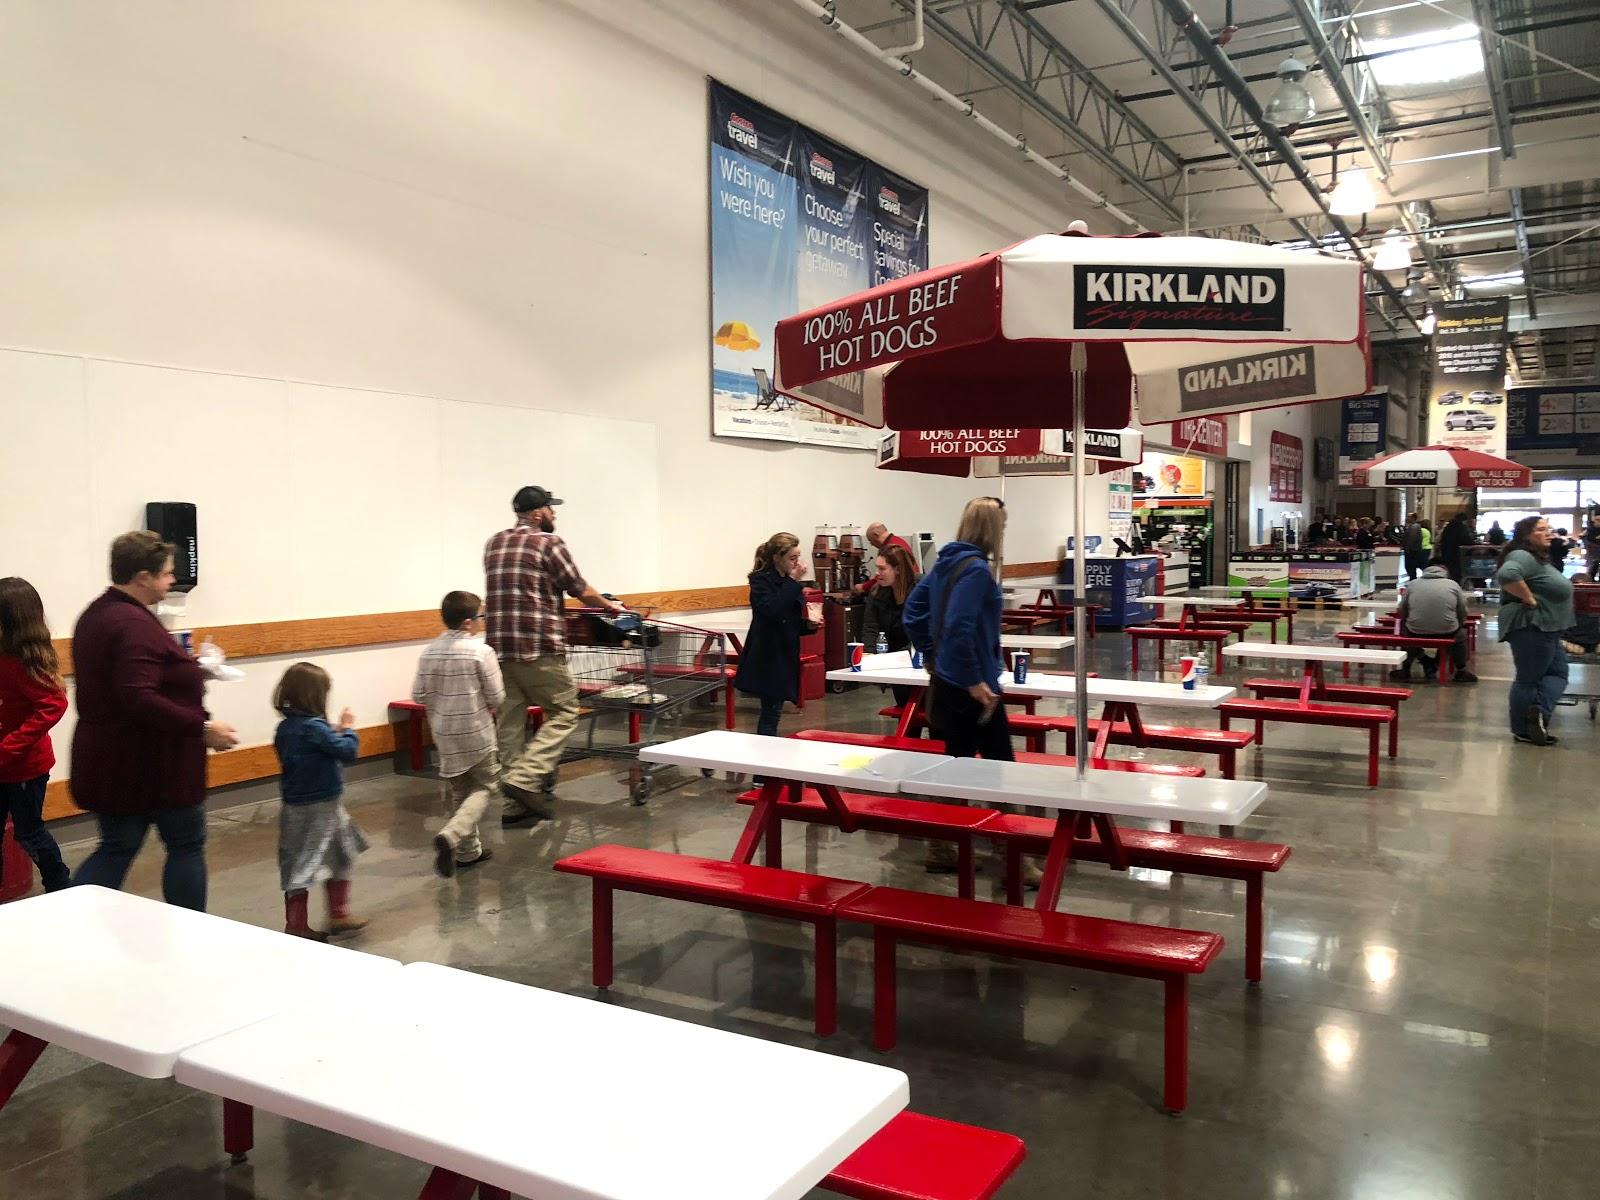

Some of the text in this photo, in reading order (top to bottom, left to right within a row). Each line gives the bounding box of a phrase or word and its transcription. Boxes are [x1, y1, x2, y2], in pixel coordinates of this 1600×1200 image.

[727, 120, 758, 149] travel
[720, 156, 775, 199] Wish you
[810, 160, 836, 185] travel
[721, 190, 785, 229] were here?
[805, 194, 844, 227] Choose
[879, 194, 900, 216] travel
[805, 224, 864, 260] your perfect
[874, 222, 905, 251] Special
[874, 250, 920, 277] savings for
[1086, 272, 1277, 304] KIRKLAND
[803, 308, 852, 345] 100%
[858, 294, 900, 330] ALL
[908, 275, 963, 317] BEEF
[1086, 302, 1276, 331] Signature
[819, 316, 938, 371] HOT DOGS
[919, 428, 1021, 440] 100% ALL BEEF
[930, 440, 1007, 454] HOT DOGS
[1065, 430, 1119, 448] KKLAND
[1387, 471, 1436, 480] KIRKLAND
[1475, 478, 1514, 486] HOT DOGS
[188, 538, 197, 578] napkins
[1086, 565, 1112, 575] PPLY
[1086, 575, 1112, 586] ERE
